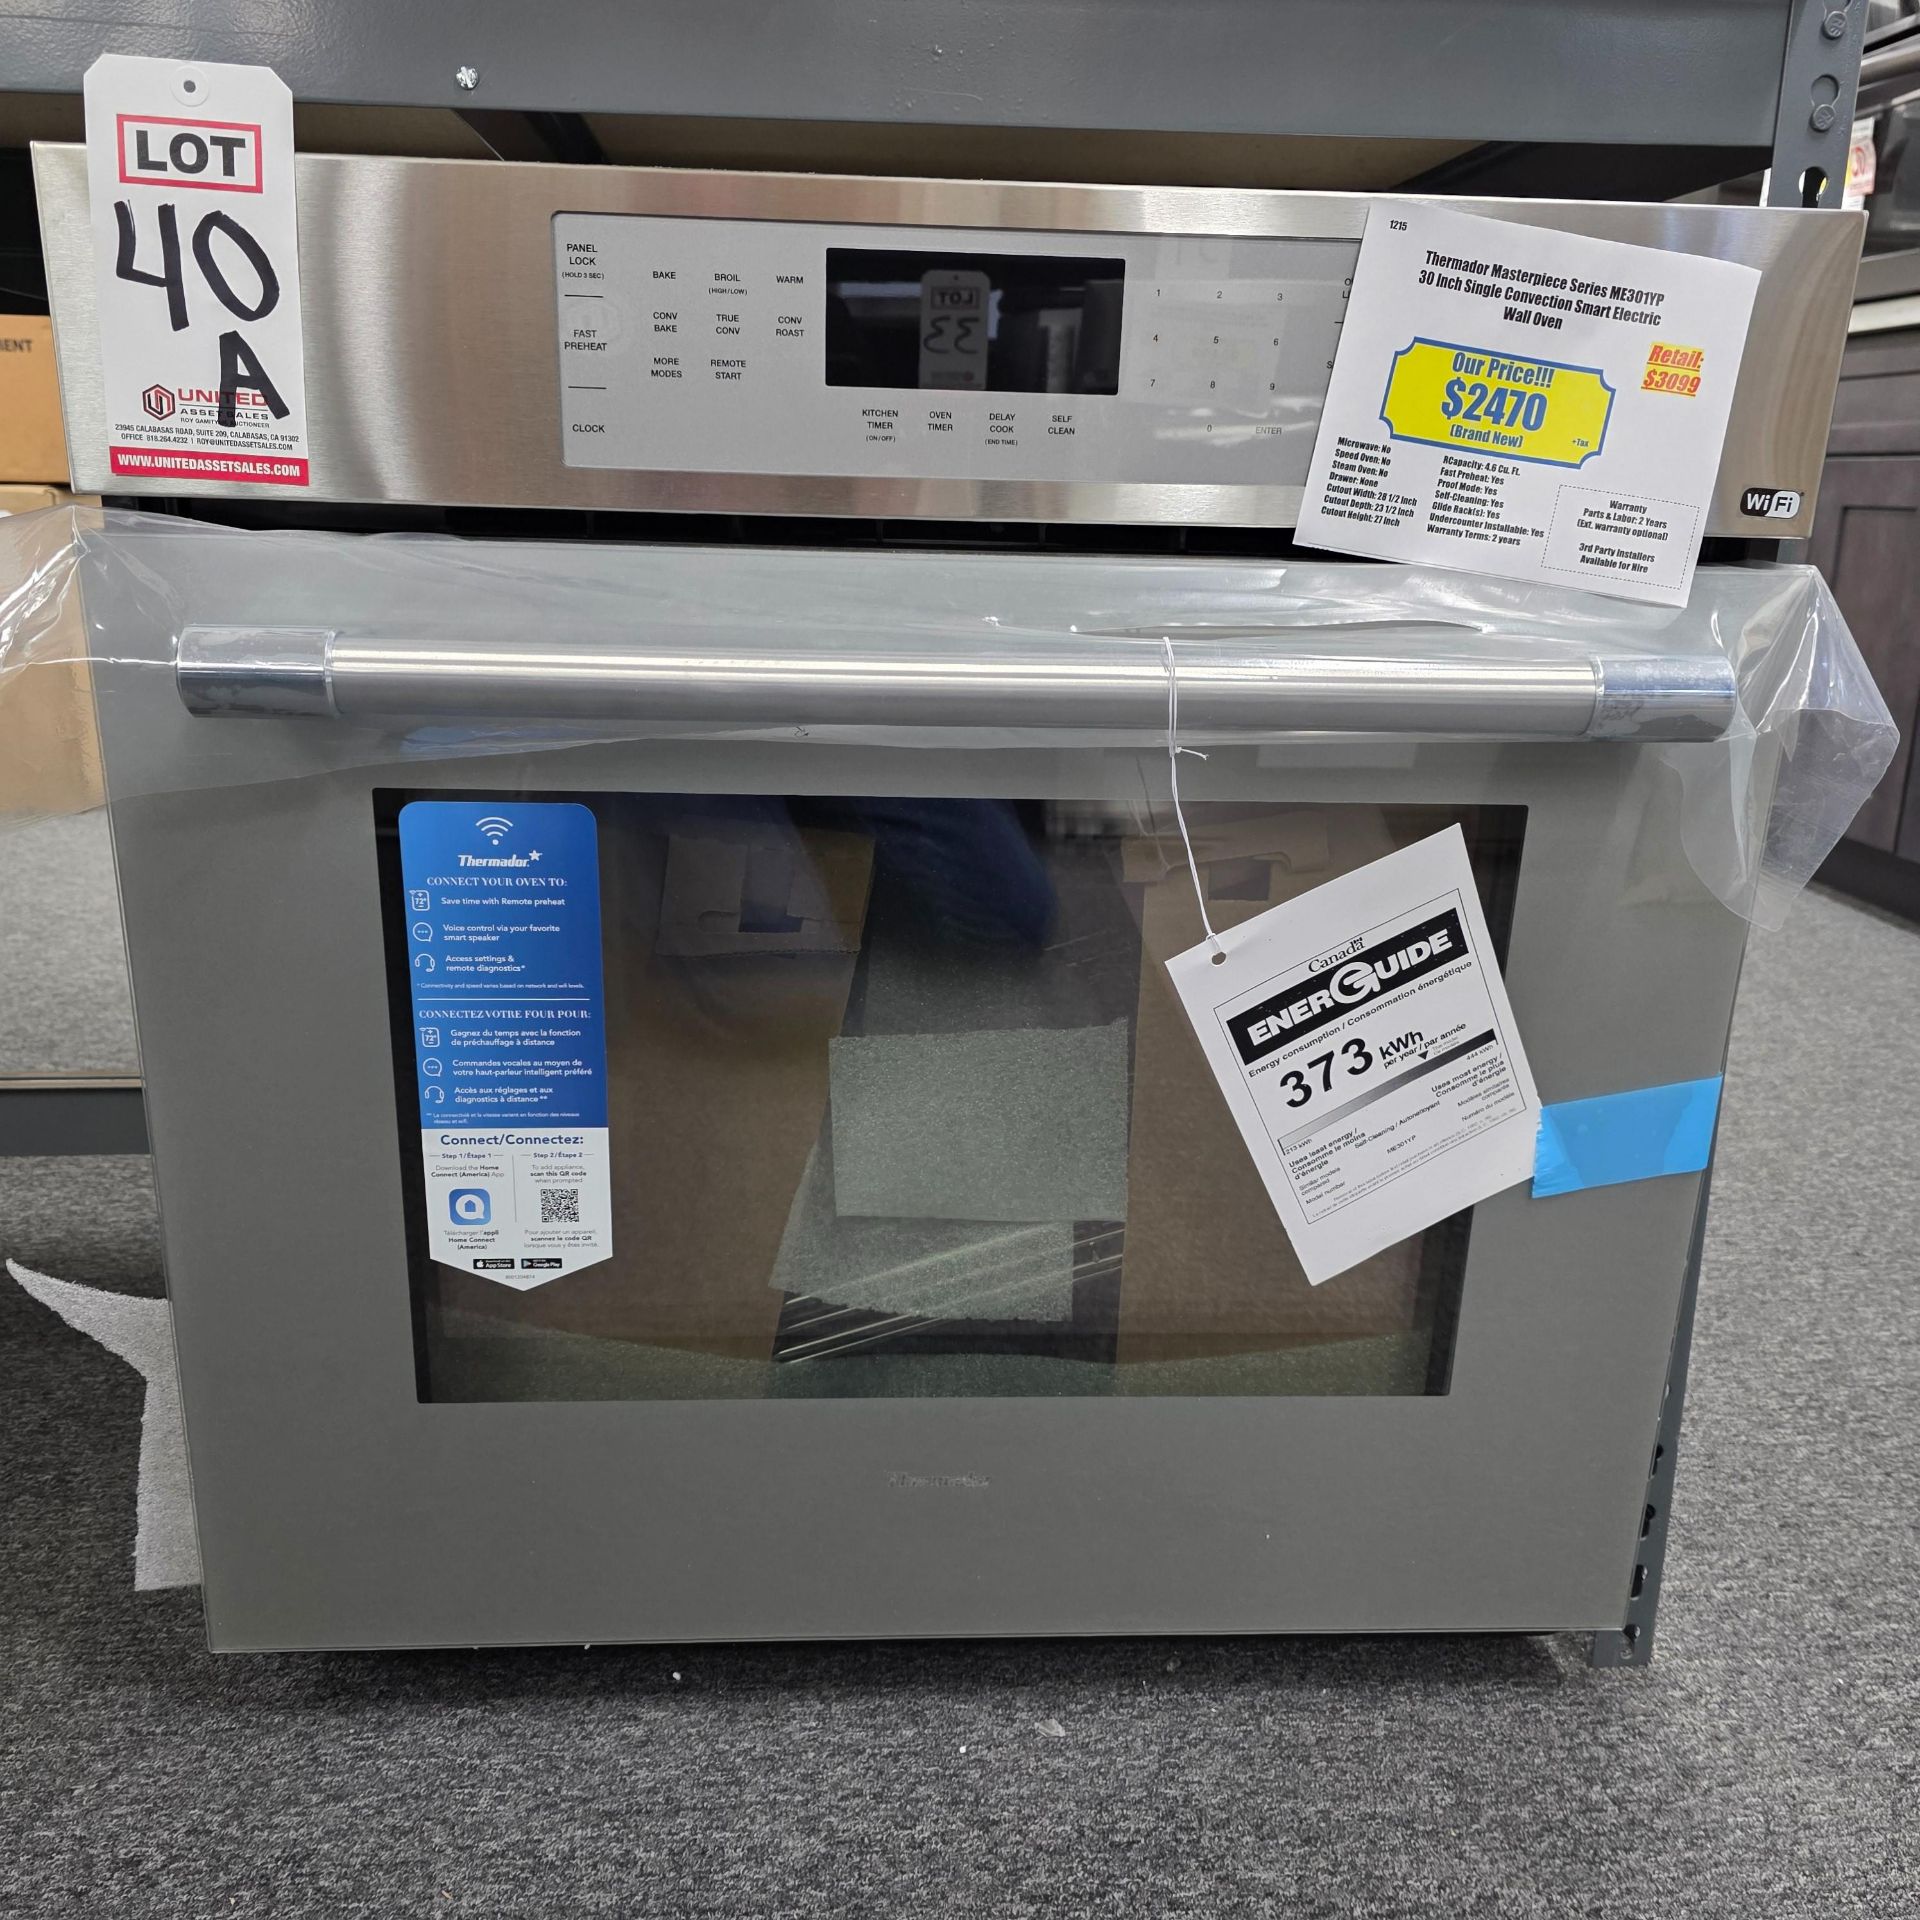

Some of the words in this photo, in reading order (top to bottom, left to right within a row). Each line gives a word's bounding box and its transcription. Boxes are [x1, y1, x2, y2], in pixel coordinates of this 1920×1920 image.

[136, 130, 246, 177] LOT
[1390, 219, 1407, 231] 1215
[567, 244, 598, 252] PANEL
[114, 199, 280, 332] 40
[569, 257, 596, 265] LOCK
[653, 271, 676, 279] BAKE
[715, 273, 740, 281] BROIL
[1426, 250, 1490, 275] Thermador
[1490, 263, 1567, 289] Masterpiece
[1569, 278, 1607, 297] Series
[1609, 285, 1664, 306] ME301YP
[776, 276, 803, 284] WARM
[709, 288, 747, 296] (HIGH/LOW)
[1217, 291, 1222, 299] 2
[1277, 293, 1283, 301] 3
[1418, 269, 1434, 285] 30
[1435, 273, 1462, 291] Inch
[1463, 278, 1502, 298] Single
[1504, 286, 1572, 311] Convection
[1574, 299, 1611, 318] Smart
[1612, 306, 1661, 325] Electric
[653, 312, 677, 320] CONV
[716, 314, 739, 322] TRUE
[778, 316, 802, 324] CONV
[1503, 306, 1532, 324] Wall
[1532, 312, 1562, 329] Oven
[574, 329, 597, 338] FAST
[716, 327, 740, 335] CONV
[776, 329, 804, 337] ROAST
[1153, 334, 1158, 342] 4
[1213, 336, 1219, 344] 5
[564, 342, 607, 351] PREHEAT
[1648, 345, 1703, 368] Retail:
[711, 359, 746, 367] REMOTE
[651, 370, 682, 378] MODES
[1452, 352, 1485, 375] Our
[1486, 358, 1554, 387] Price!!!
[218, 330, 291, 427] A
[715, 372, 742, 380] START
[1643, 368, 1701, 393] $3099
[1151, 379, 1155, 387] 7
[1210, 381, 1215, 389] 8
[1269, 383, 1275, 391] 9
[1441, 376, 1547, 431] $2470
[862, 409, 898, 417] KITCHEN
[930, 411, 951, 419] OVEN
[989, 413, 1015, 421] DELAY
[572, 424, 605, 433] CLOCK
[928, 423, 953, 431] TIMER
[990, 425, 1013, 433] COOK
[1048, 427, 1075, 435] CLEAN
[1206, 424, 1212, 433] 0
[1255, 426, 1283, 435] ENTER
[115, 423, 134, 431] 23945
[135, 424, 173, 433] CALABASAS
[175, 427, 194, 436] ROAD,
[195, 428, 213, 436] SUITE
[215, 430, 228, 438] 209,
[229, 431, 269, 441] CALABASAS,
[280, 434, 299, 442] 91302
[1449, 424, 1490, 442] (Brand
[1492, 431, 1523, 447] New)
[866, 435, 895, 443] (ON/OFF)
[1337, 436, 1380, 452] Microwave:
[1381, 444, 1391, 453] No
[1334, 448, 1359, 460] Speed
[1359, 452, 1380, 464] Oven:
[1380, 456, 1390, 465] No
[117, 453, 300, 477] WWW.UNITEDASSETSALES.COM
[1442, 455, 1483, 470] RCapacity:
[1484, 462, 1497, 472] 4.6
[1497, 464, 1509, 474] Cu.
[1511, 466, 1520, 475] Ft.
[1329, 471, 1358, 484] Drawer:
[1359, 476, 1378, 487] None
[1439, 466, 1456, 477] Fast
[1456, 469, 1489, 482] Preheat:
[1491, 475, 1504, 484] Yes
[1326, 483, 1352, 495] Cutout
[1352, 487, 1376, 499] Width:
[1377, 491, 1387, 501] 28
[1388, 493, 1400, 503] 1/2
[1400, 496, 1417, 506] Inch
[1434, 489, 1489, 506] Self-Cleaning:
[1490, 498, 1504, 508] Yes
[1609, 500, 1647, 514] Warranty
[1745, 491, 1797, 515] WiFi
[1583, 507, 1604, 518] Parts
[1612, 512, 1637, 524] Labor:
[1638, 516, 1644, 525] 2
[1645, 517, 1667, 528] Years
[1576, 518, 1593, 529] (Ext.
[1594, 523, 1631, 535] warranty
[1631, 529, 1668, 540] optional)
[1578, 542, 1593, 552] 3rd
[1593, 545, 1615, 556] Party
[1616, 548, 1655, 562] Installers
[1579, 554, 1617, 568] Available
[1618, 561, 1630, 570] for
[1631, 563, 1648, 573] Hire
[458, 854, 528, 867] Thermador
[426, 877, 479, 885] CONNECT
[481, 877, 512, 886] YOUR
[515, 877, 545, 885] OVEN
[548, 878, 566, 886] TO:
[534, 898, 565, 906] preheat
[468, 934, 499, 943] speaker
[1308, 938, 1366, 974] Canada
[1247, 928, 1453, 1046] ENERGUIDE
[1248, 1057, 1279, 1077] Energy
[1282, 1026, 1340, 1059] consumption
[1347, 988, 1415, 1025] Consommation
[1417, 961, 1471, 990] énergétique
[1379, 1031, 1423, 1060] kWh
[1383, 1057, 1396, 1069] per
[1398, 1046, 1417, 1061] year
[1423, 1037, 1438, 1049] par
[1440, 1023, 1466, 1040] année
[1280, 1038, 1372, 1107] 373
[440, 1133, 583, 1145] Connect/Connectez:
